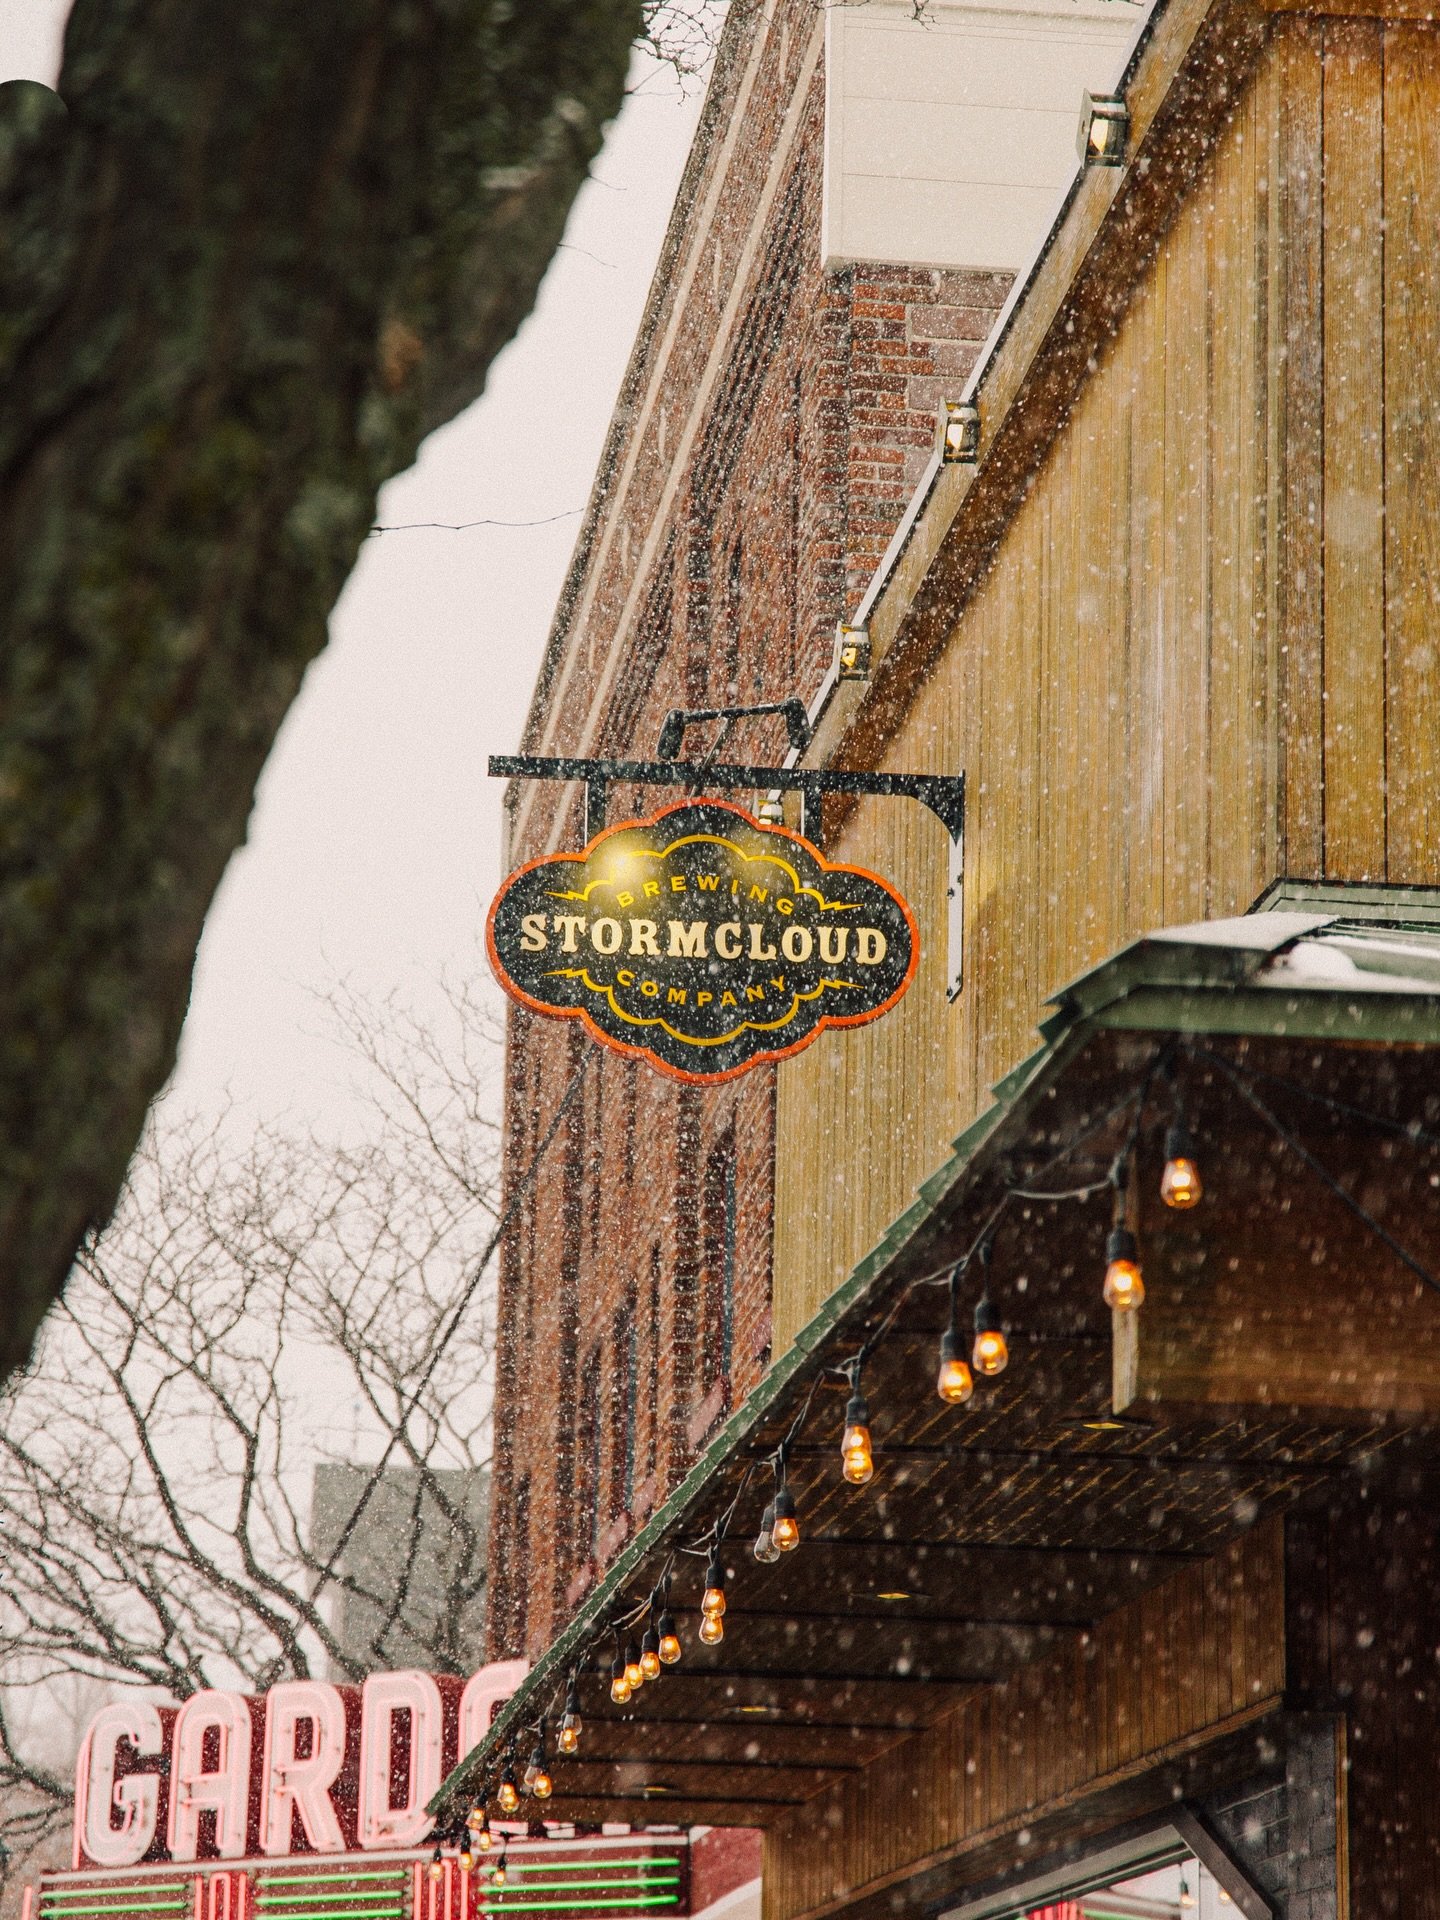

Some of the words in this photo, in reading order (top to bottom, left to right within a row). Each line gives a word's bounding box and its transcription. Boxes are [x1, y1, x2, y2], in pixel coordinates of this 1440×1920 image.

[616, 875, 794, 916] BREWING
[519, 913, 888, 965] STORMCLOUD
[616, 969, 787, 1007] COMPANY
[80, 1660, 631, 1867] GARD
